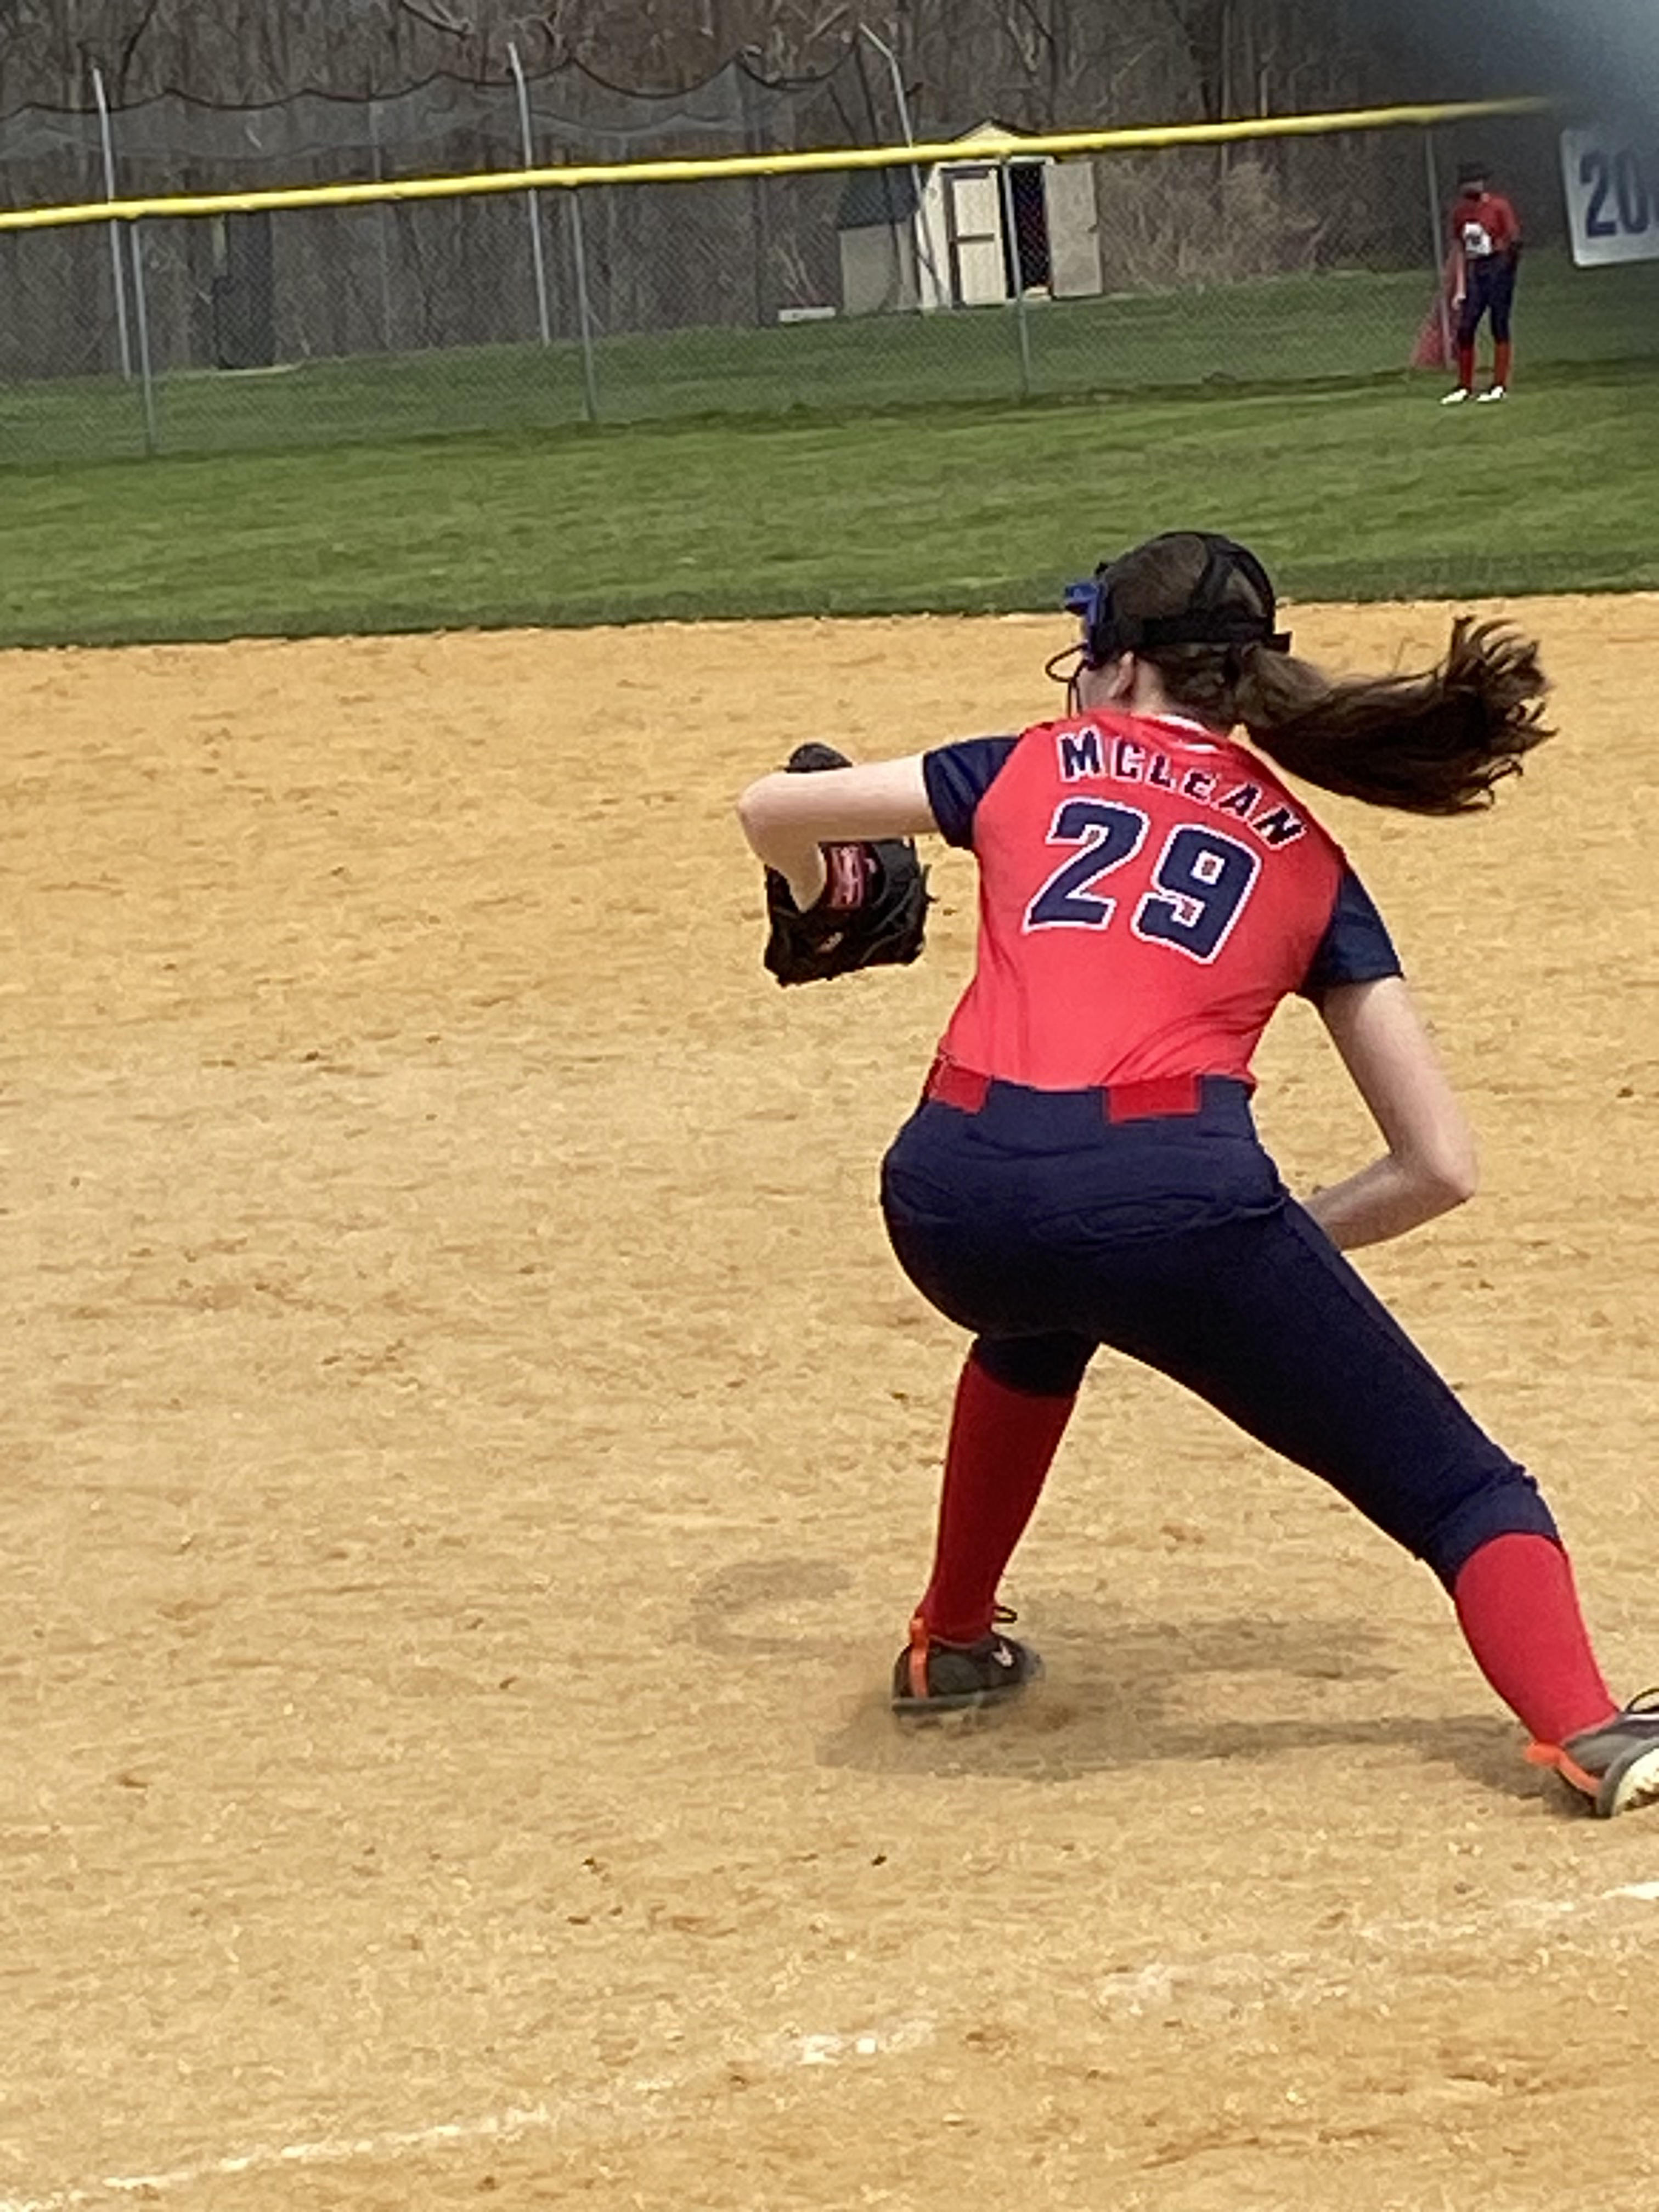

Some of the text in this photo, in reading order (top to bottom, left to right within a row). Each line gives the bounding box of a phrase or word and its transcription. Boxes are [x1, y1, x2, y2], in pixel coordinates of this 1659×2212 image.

[1579, 147, 1659, 238] 20
[1057, 725, 1307, 850] MCLEAN
[1022, 796, 1261, 964] 29
